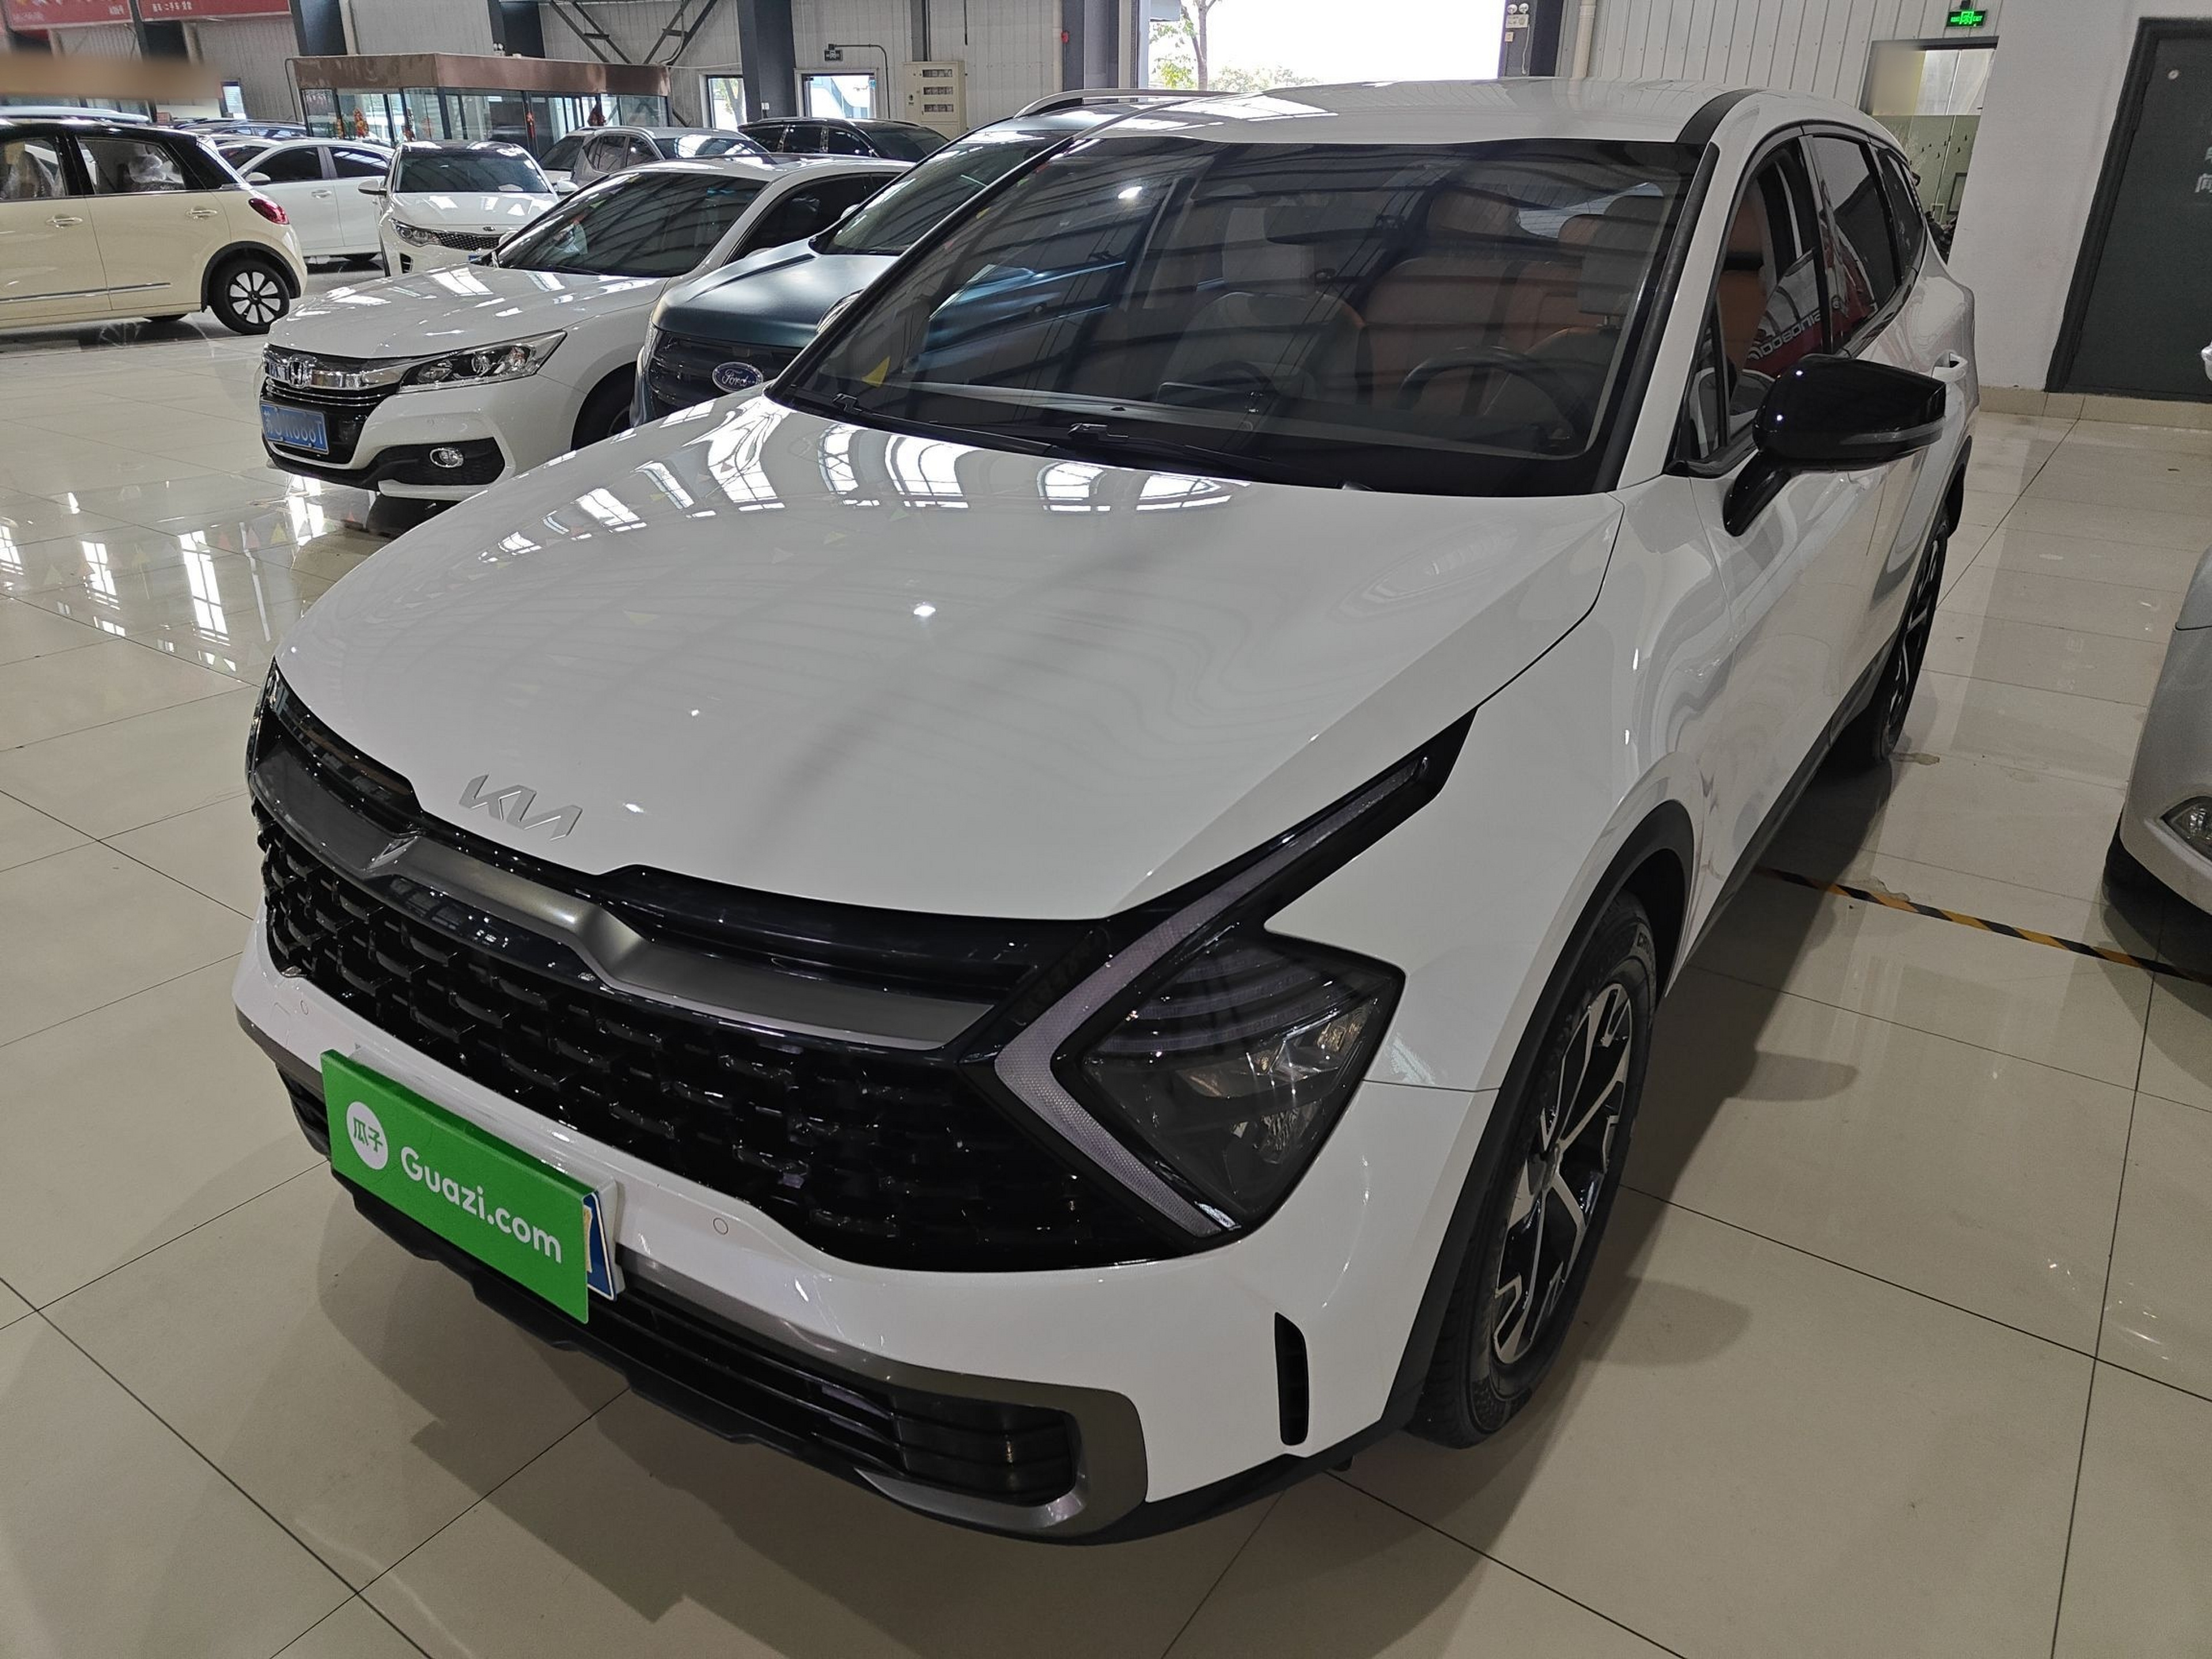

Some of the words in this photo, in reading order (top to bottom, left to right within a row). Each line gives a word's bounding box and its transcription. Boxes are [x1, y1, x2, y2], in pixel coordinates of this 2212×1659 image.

[721, 368, 749, 387] Ford
[459, 774, 582, 842] KIA
[353, 1117, 383, 1153] 瓜子
[400, 1146, 562, 1263] Guazi.com
